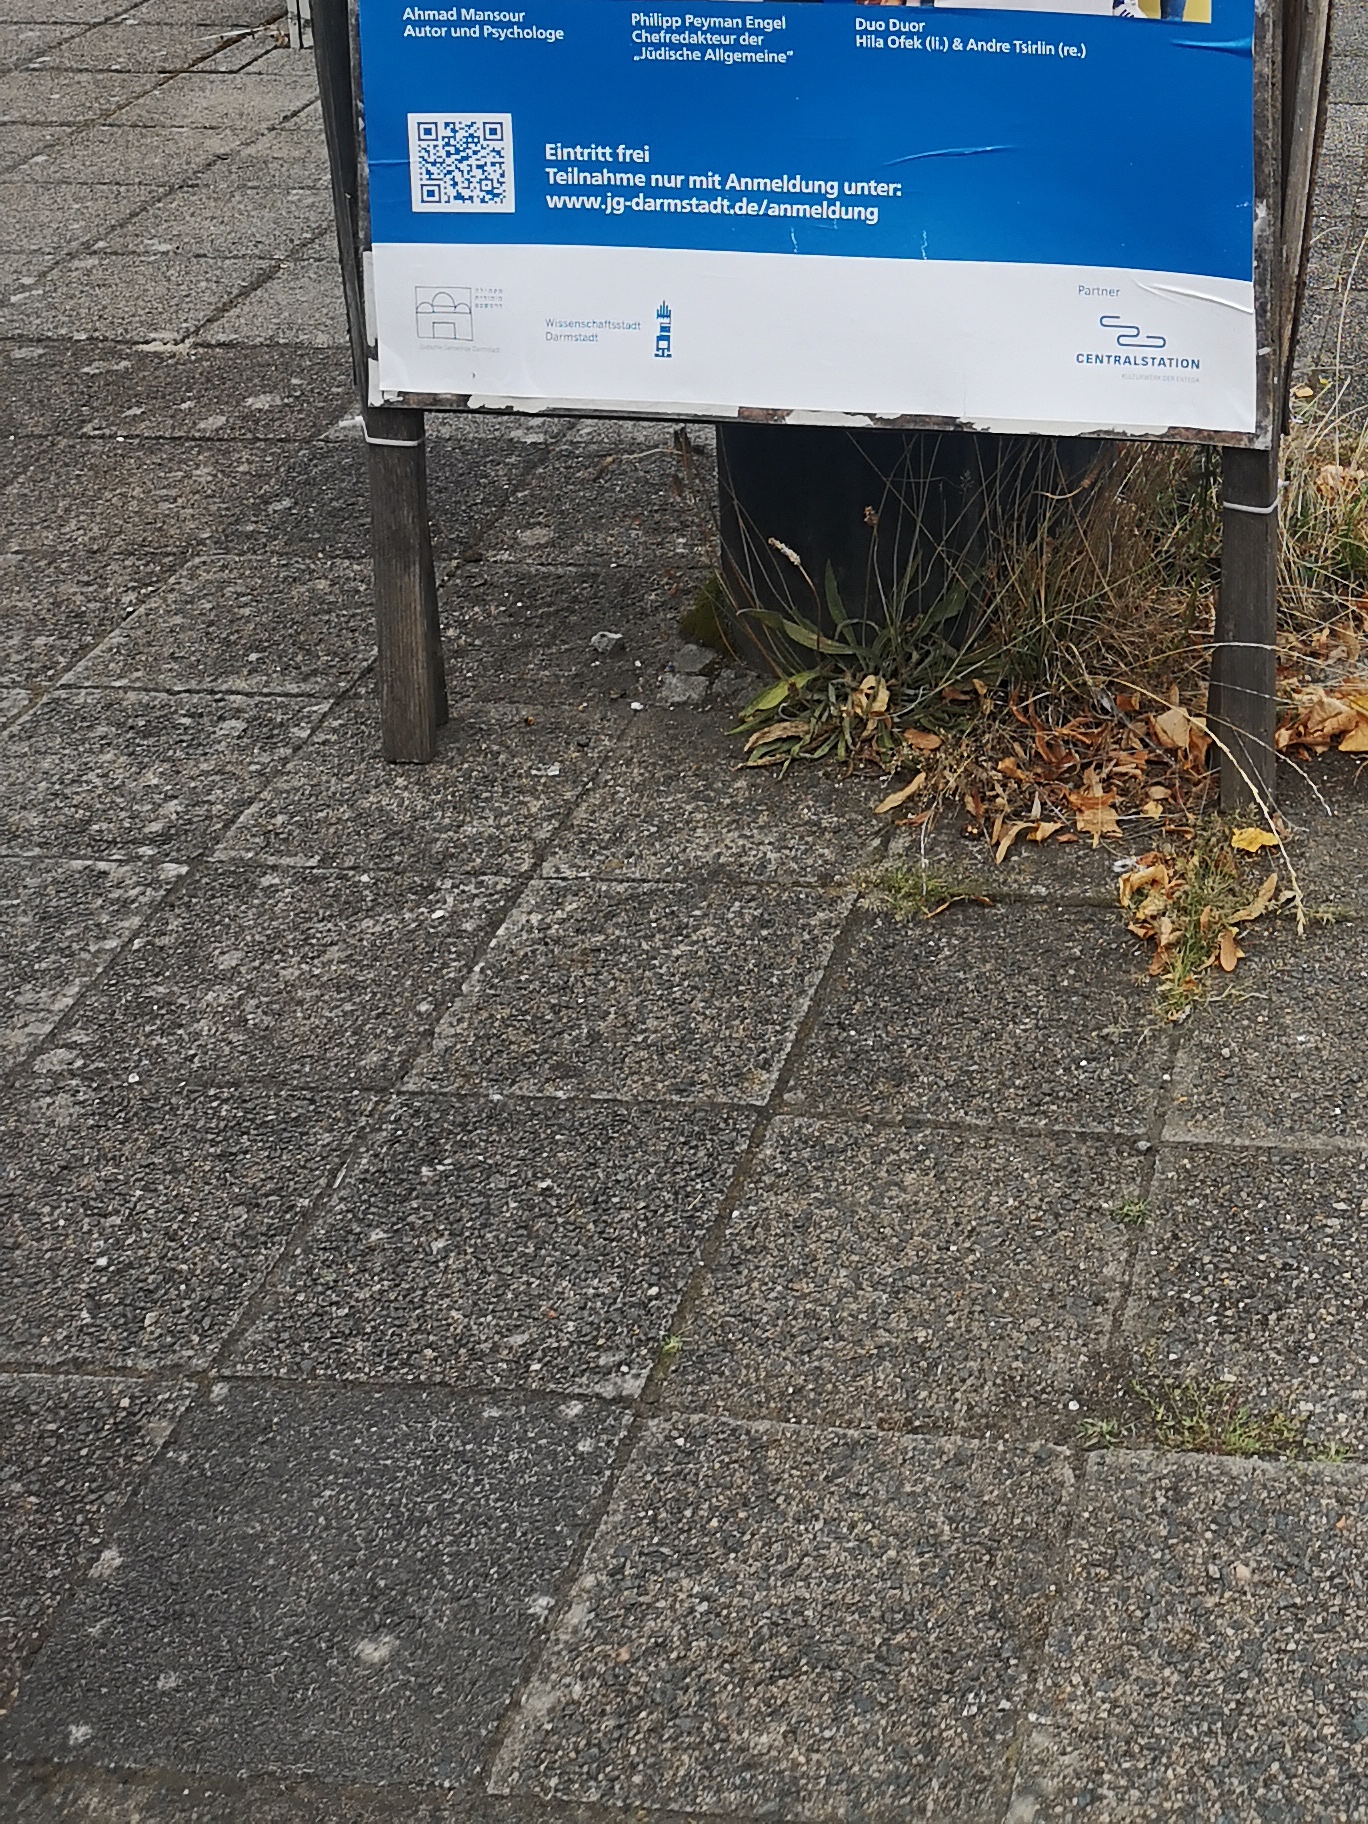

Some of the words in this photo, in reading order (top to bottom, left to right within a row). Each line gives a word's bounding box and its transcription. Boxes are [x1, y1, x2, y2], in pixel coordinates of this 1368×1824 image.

[403, 7, 457, 20] Ahmad
[461, 9, 525, 22] Mansour
[632, 13, 681, 30] Philipp
[686, 15, 742, 30] Peyman
[746, 16, 785, 32] Engel
[856, 18, 885, 30] Duo
[889, 19, 925, 32] Duor
[404, 25, 447, 37] Autor
[451, 25, 479, 37] und
[484, 25, 564, 42] Psychologe
[632, 30, 736, 44] Chefredakteur
[740, 33, 763, 45] der
[856, 35, 883, 48] Hila
[888, 35, 922, 48] Ofek
[926, 36, 948, 52] (li.)
[952, 38, 963, 50] &
[967, 39, 1010, 52] Andre
[1013, 41, 1054, 55] Tsirlin
[1059, 42, 1086, 58] (re.)
[546, 143, 613, 161] Eintritt
[616, 145, 649, 162] frei
[546, 167, 645, 186] Teilnahme
[651, 175, 685, 188] nur
[689, 172, 721, 189] mit
[725, 174, 838, 198] Anmeldung
[844, 180, 901, 196] unter:
[546, 193, 878, 224] www.jg-darmstadt.de/anmeldung
[1078, 284, 1120, 297] Partner
[545, 318, 641, 330] Wissenschaftsstadt
[545, 331, 599, 343] Darmstadt
[1076, 353, 1200, 369] CENTRALSTATION
